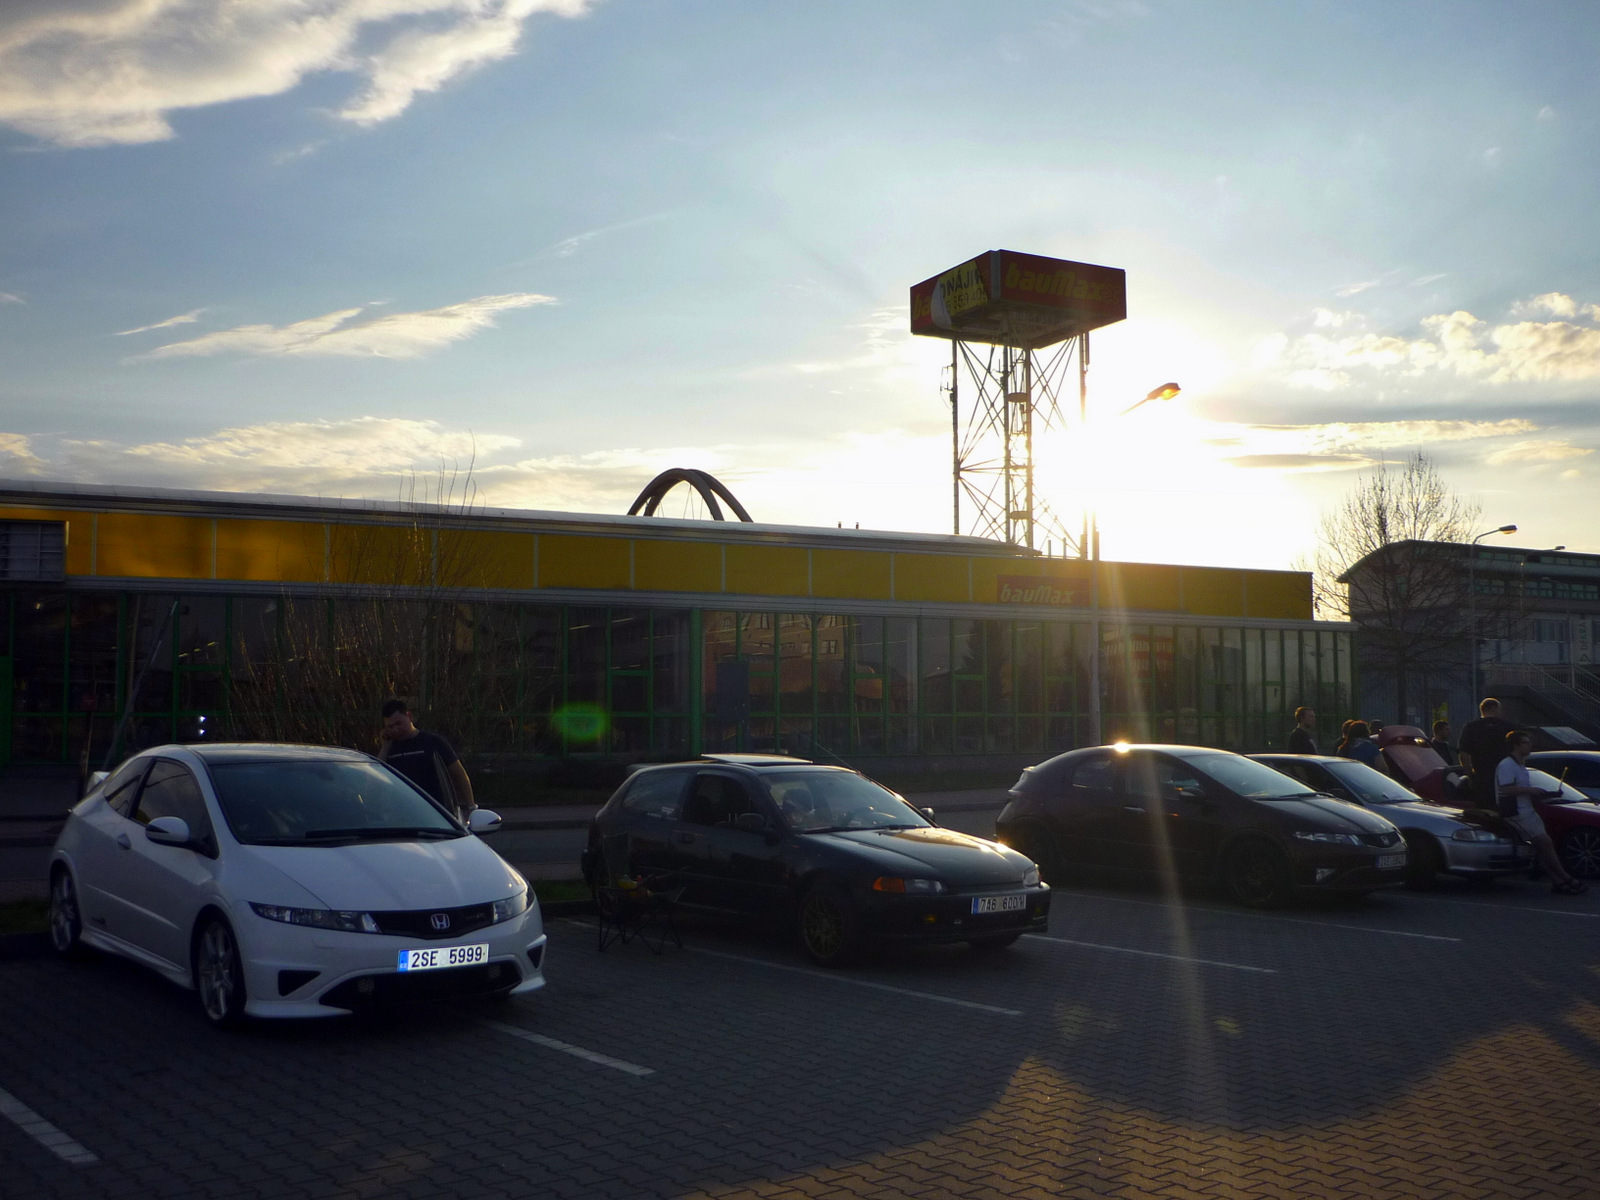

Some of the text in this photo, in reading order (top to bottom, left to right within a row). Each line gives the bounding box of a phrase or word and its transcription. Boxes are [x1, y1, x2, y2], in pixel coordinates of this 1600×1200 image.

[1000, 584, 1074, 604] bauMax
[411, 951, 438, 968] 2SE
[449, 946, 482, 964] 5999
